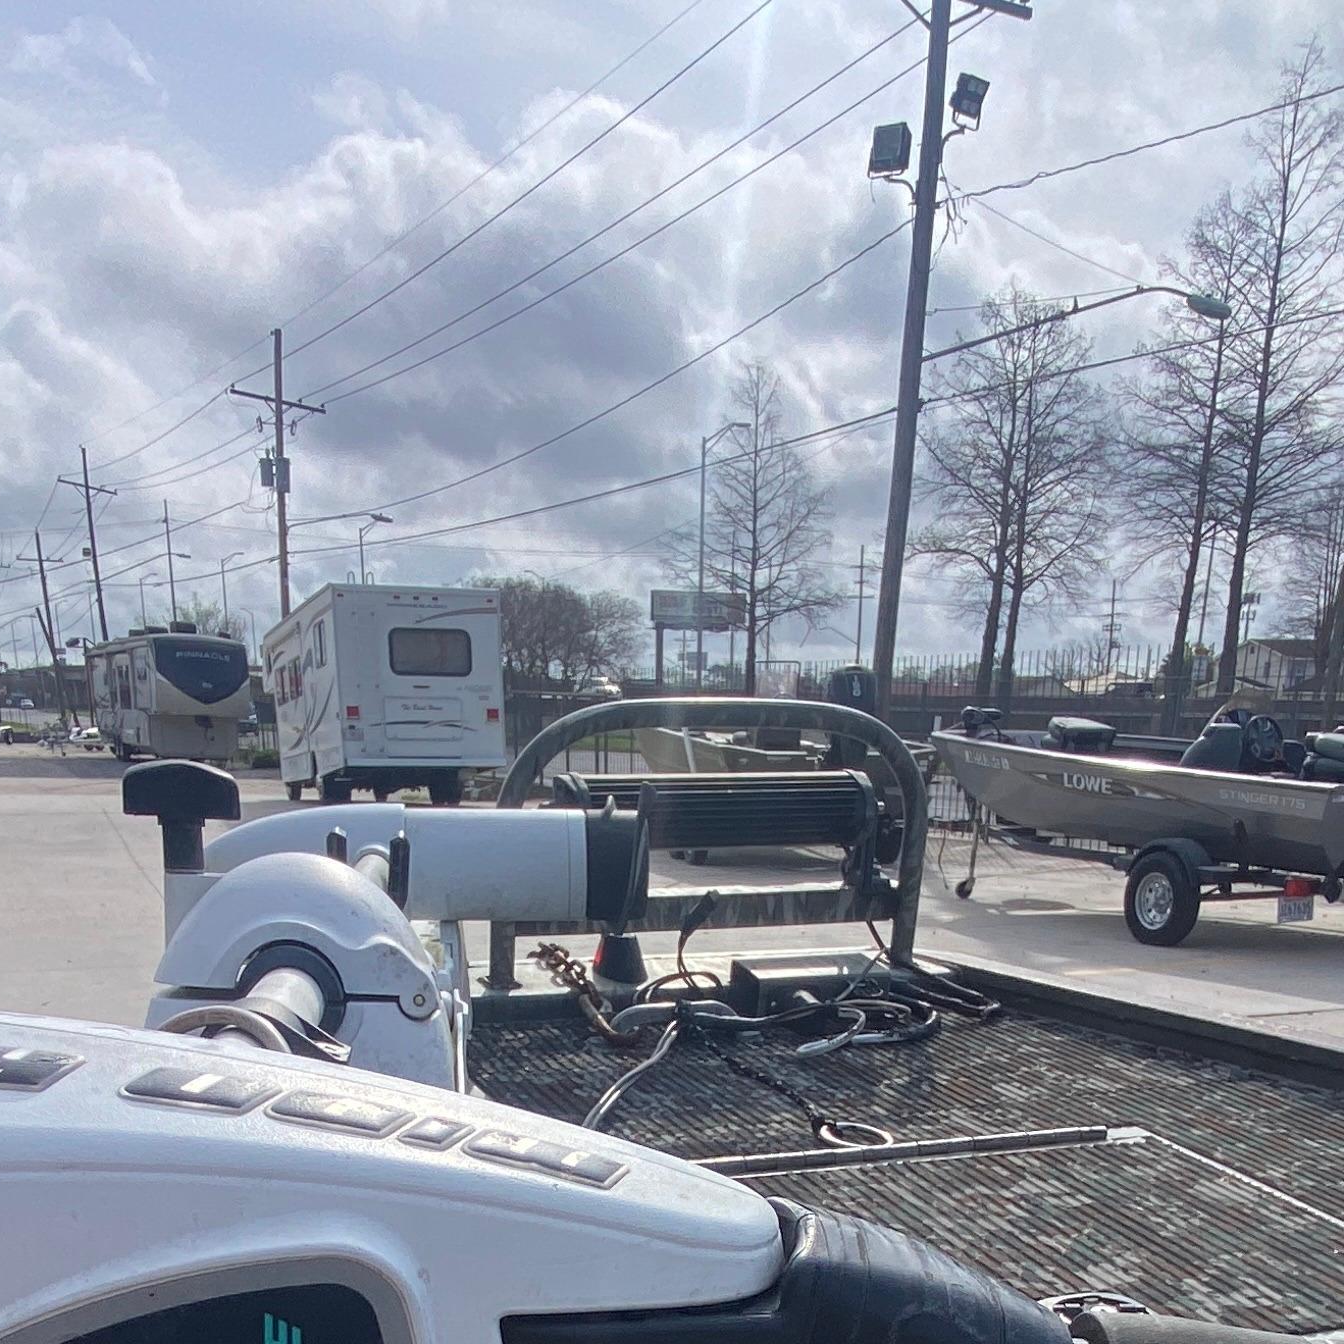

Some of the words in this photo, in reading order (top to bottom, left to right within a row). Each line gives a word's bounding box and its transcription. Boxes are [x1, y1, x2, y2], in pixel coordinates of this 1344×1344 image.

[1063, 772, 1113, 795] LOWE
[1218, 788, 1279, 807] STINGER
[1282, 796, 1306, 810] 175
